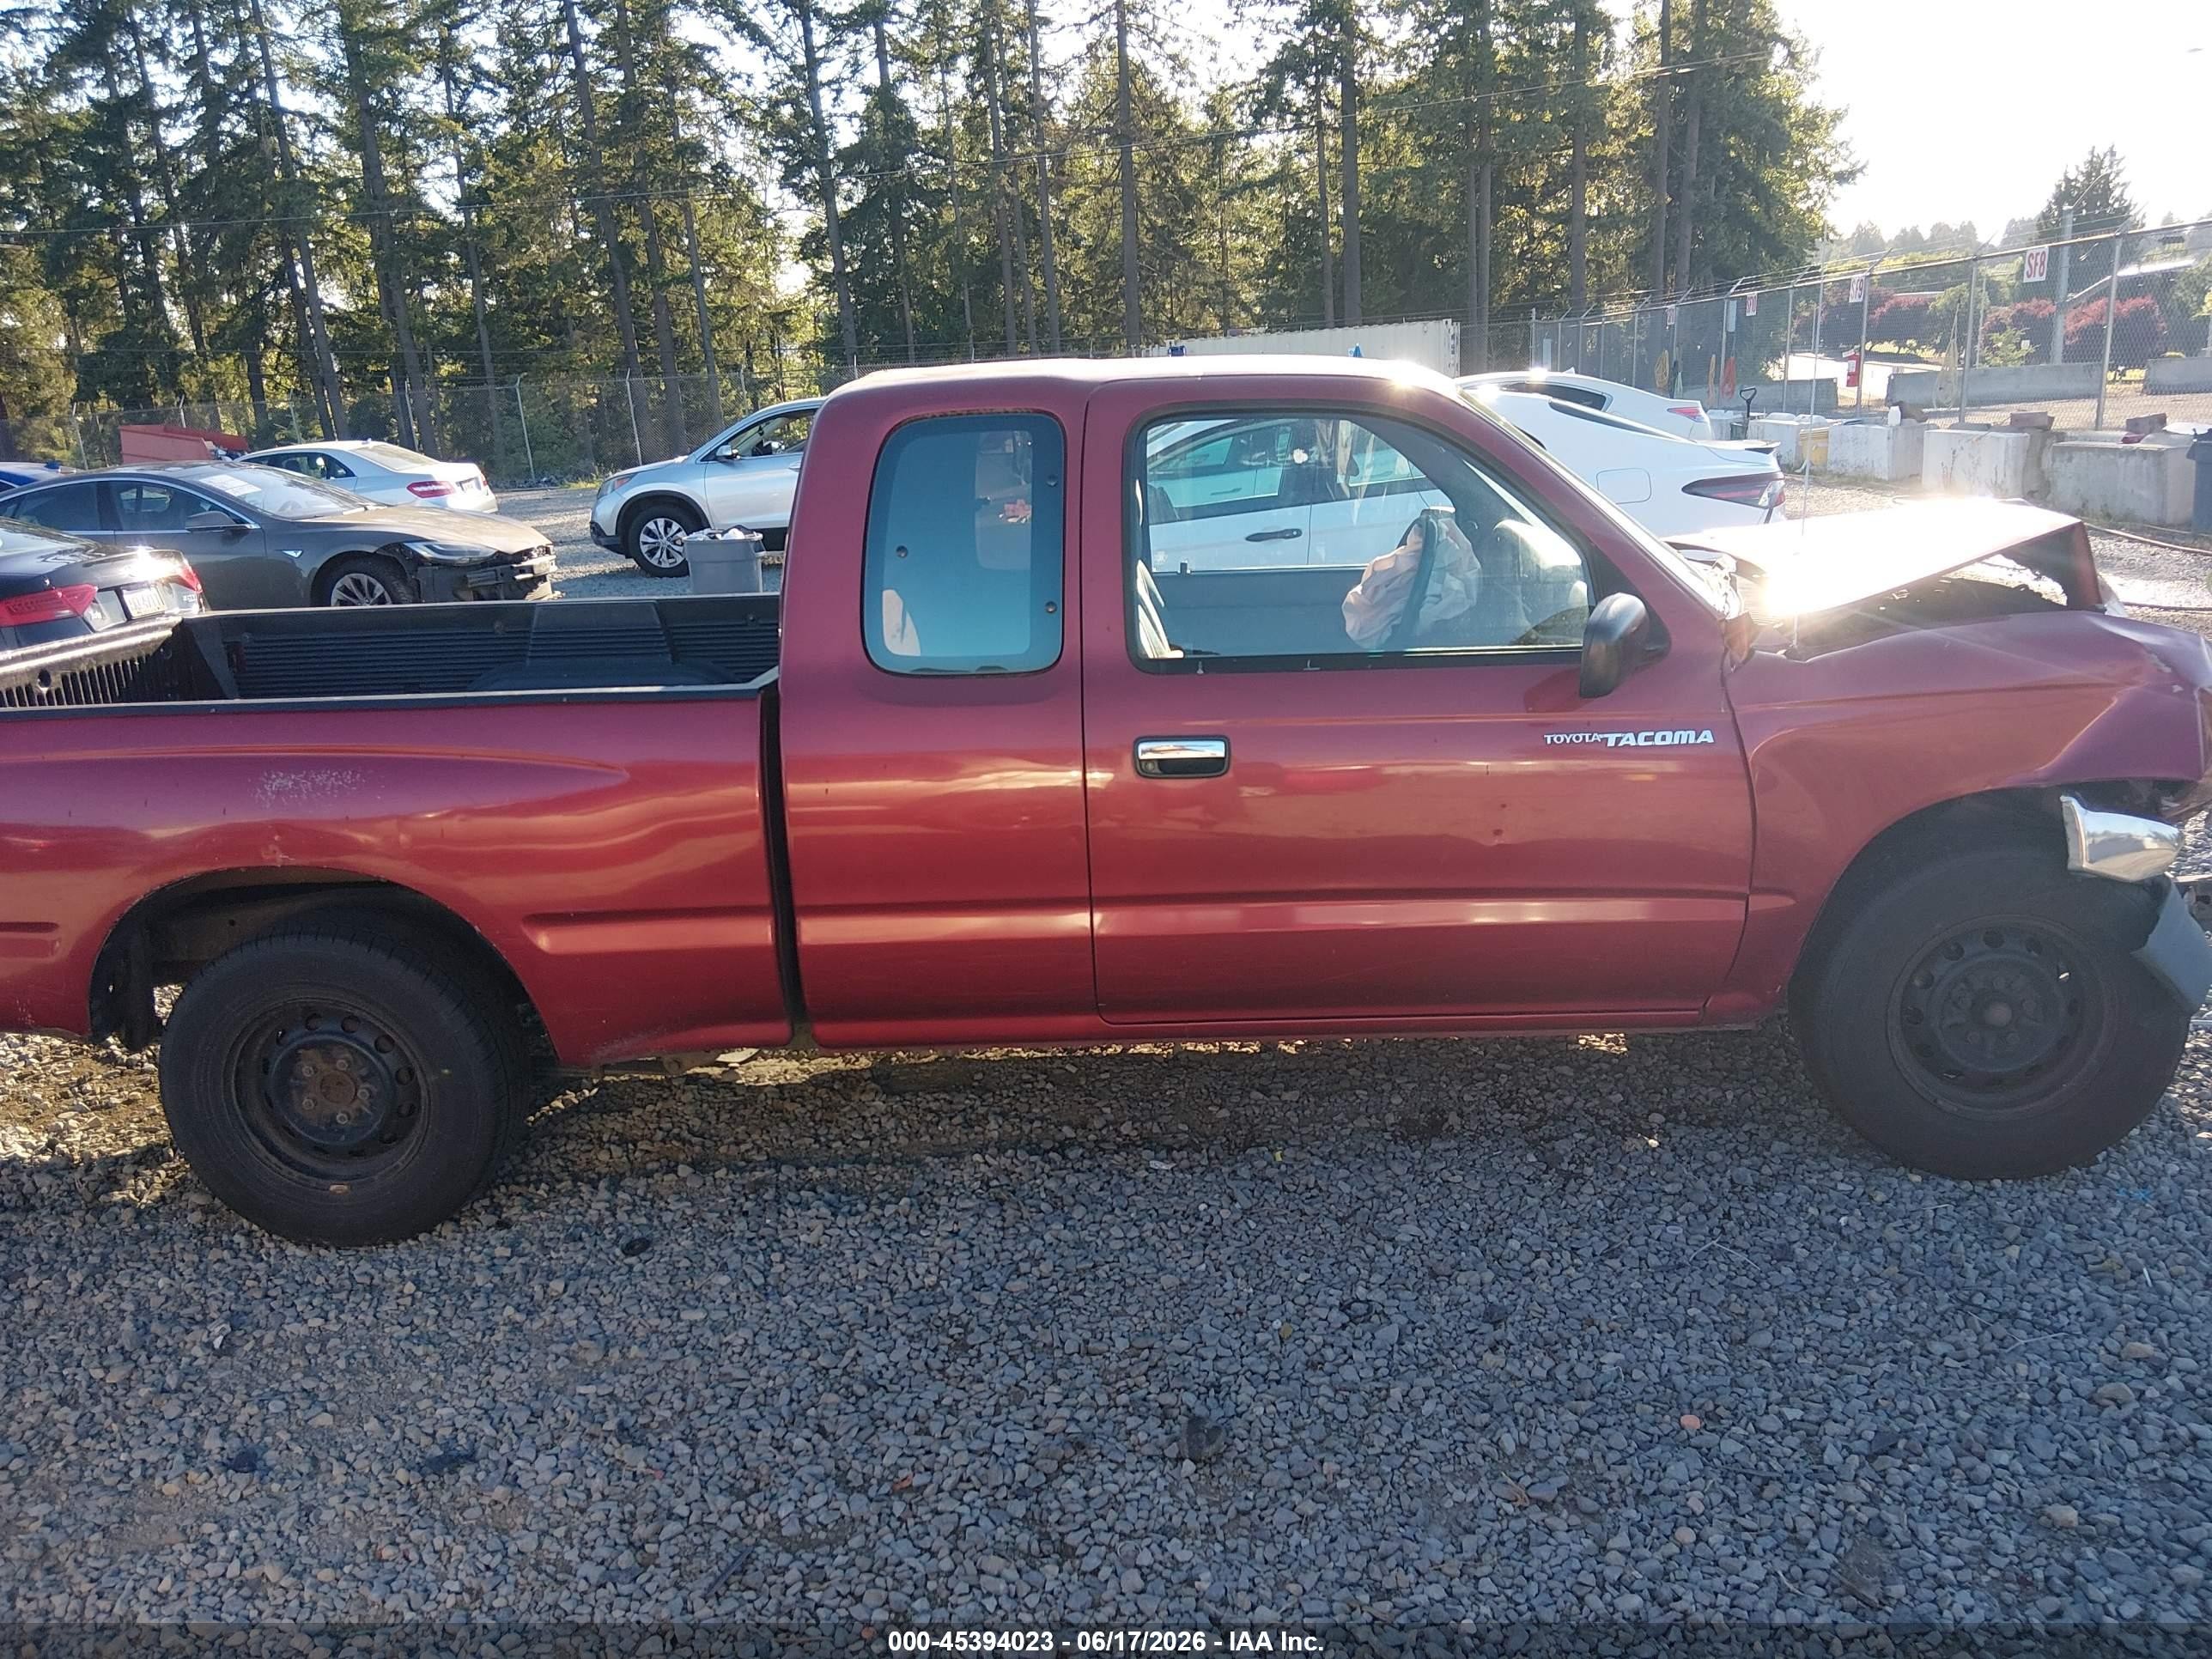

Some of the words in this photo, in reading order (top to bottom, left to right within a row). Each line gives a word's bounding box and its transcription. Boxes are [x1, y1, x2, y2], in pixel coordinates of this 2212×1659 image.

[2027, 251, 2046, 278] SF8
[1543, 732, 1601, 745] TOYOTA
[1601, 730, 1715, 747] TACOMA
